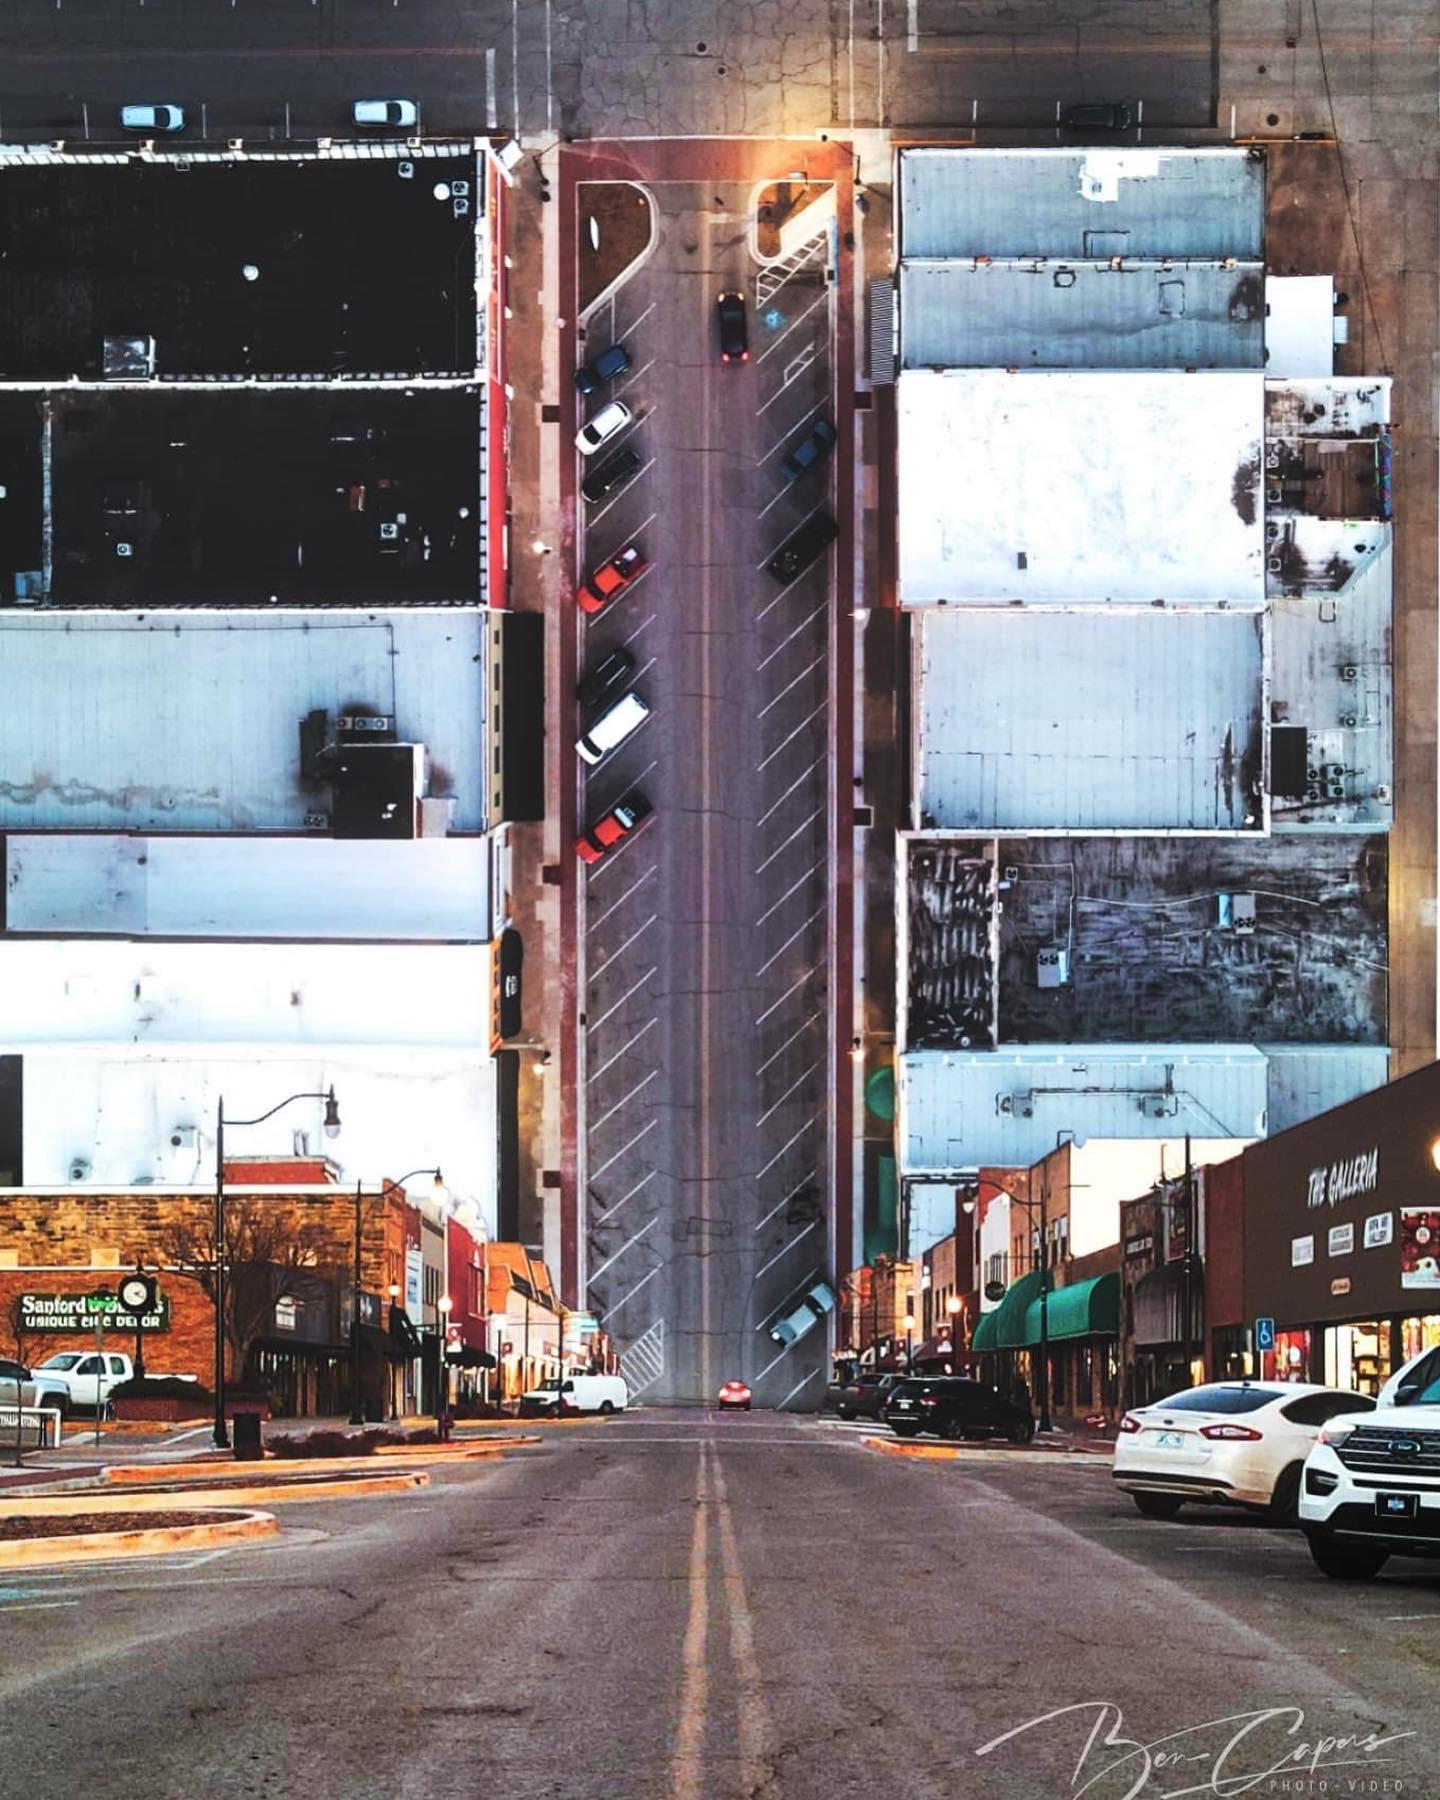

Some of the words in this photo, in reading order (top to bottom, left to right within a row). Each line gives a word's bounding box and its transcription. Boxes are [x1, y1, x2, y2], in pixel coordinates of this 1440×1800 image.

[1308, 1167, 1328, 1208] THE
[1328, 1144, 1379, 1209] GALLERIA
[21, 1295, 87, 1315] Sanford
[81, 1316, 111, 1328] CHC
